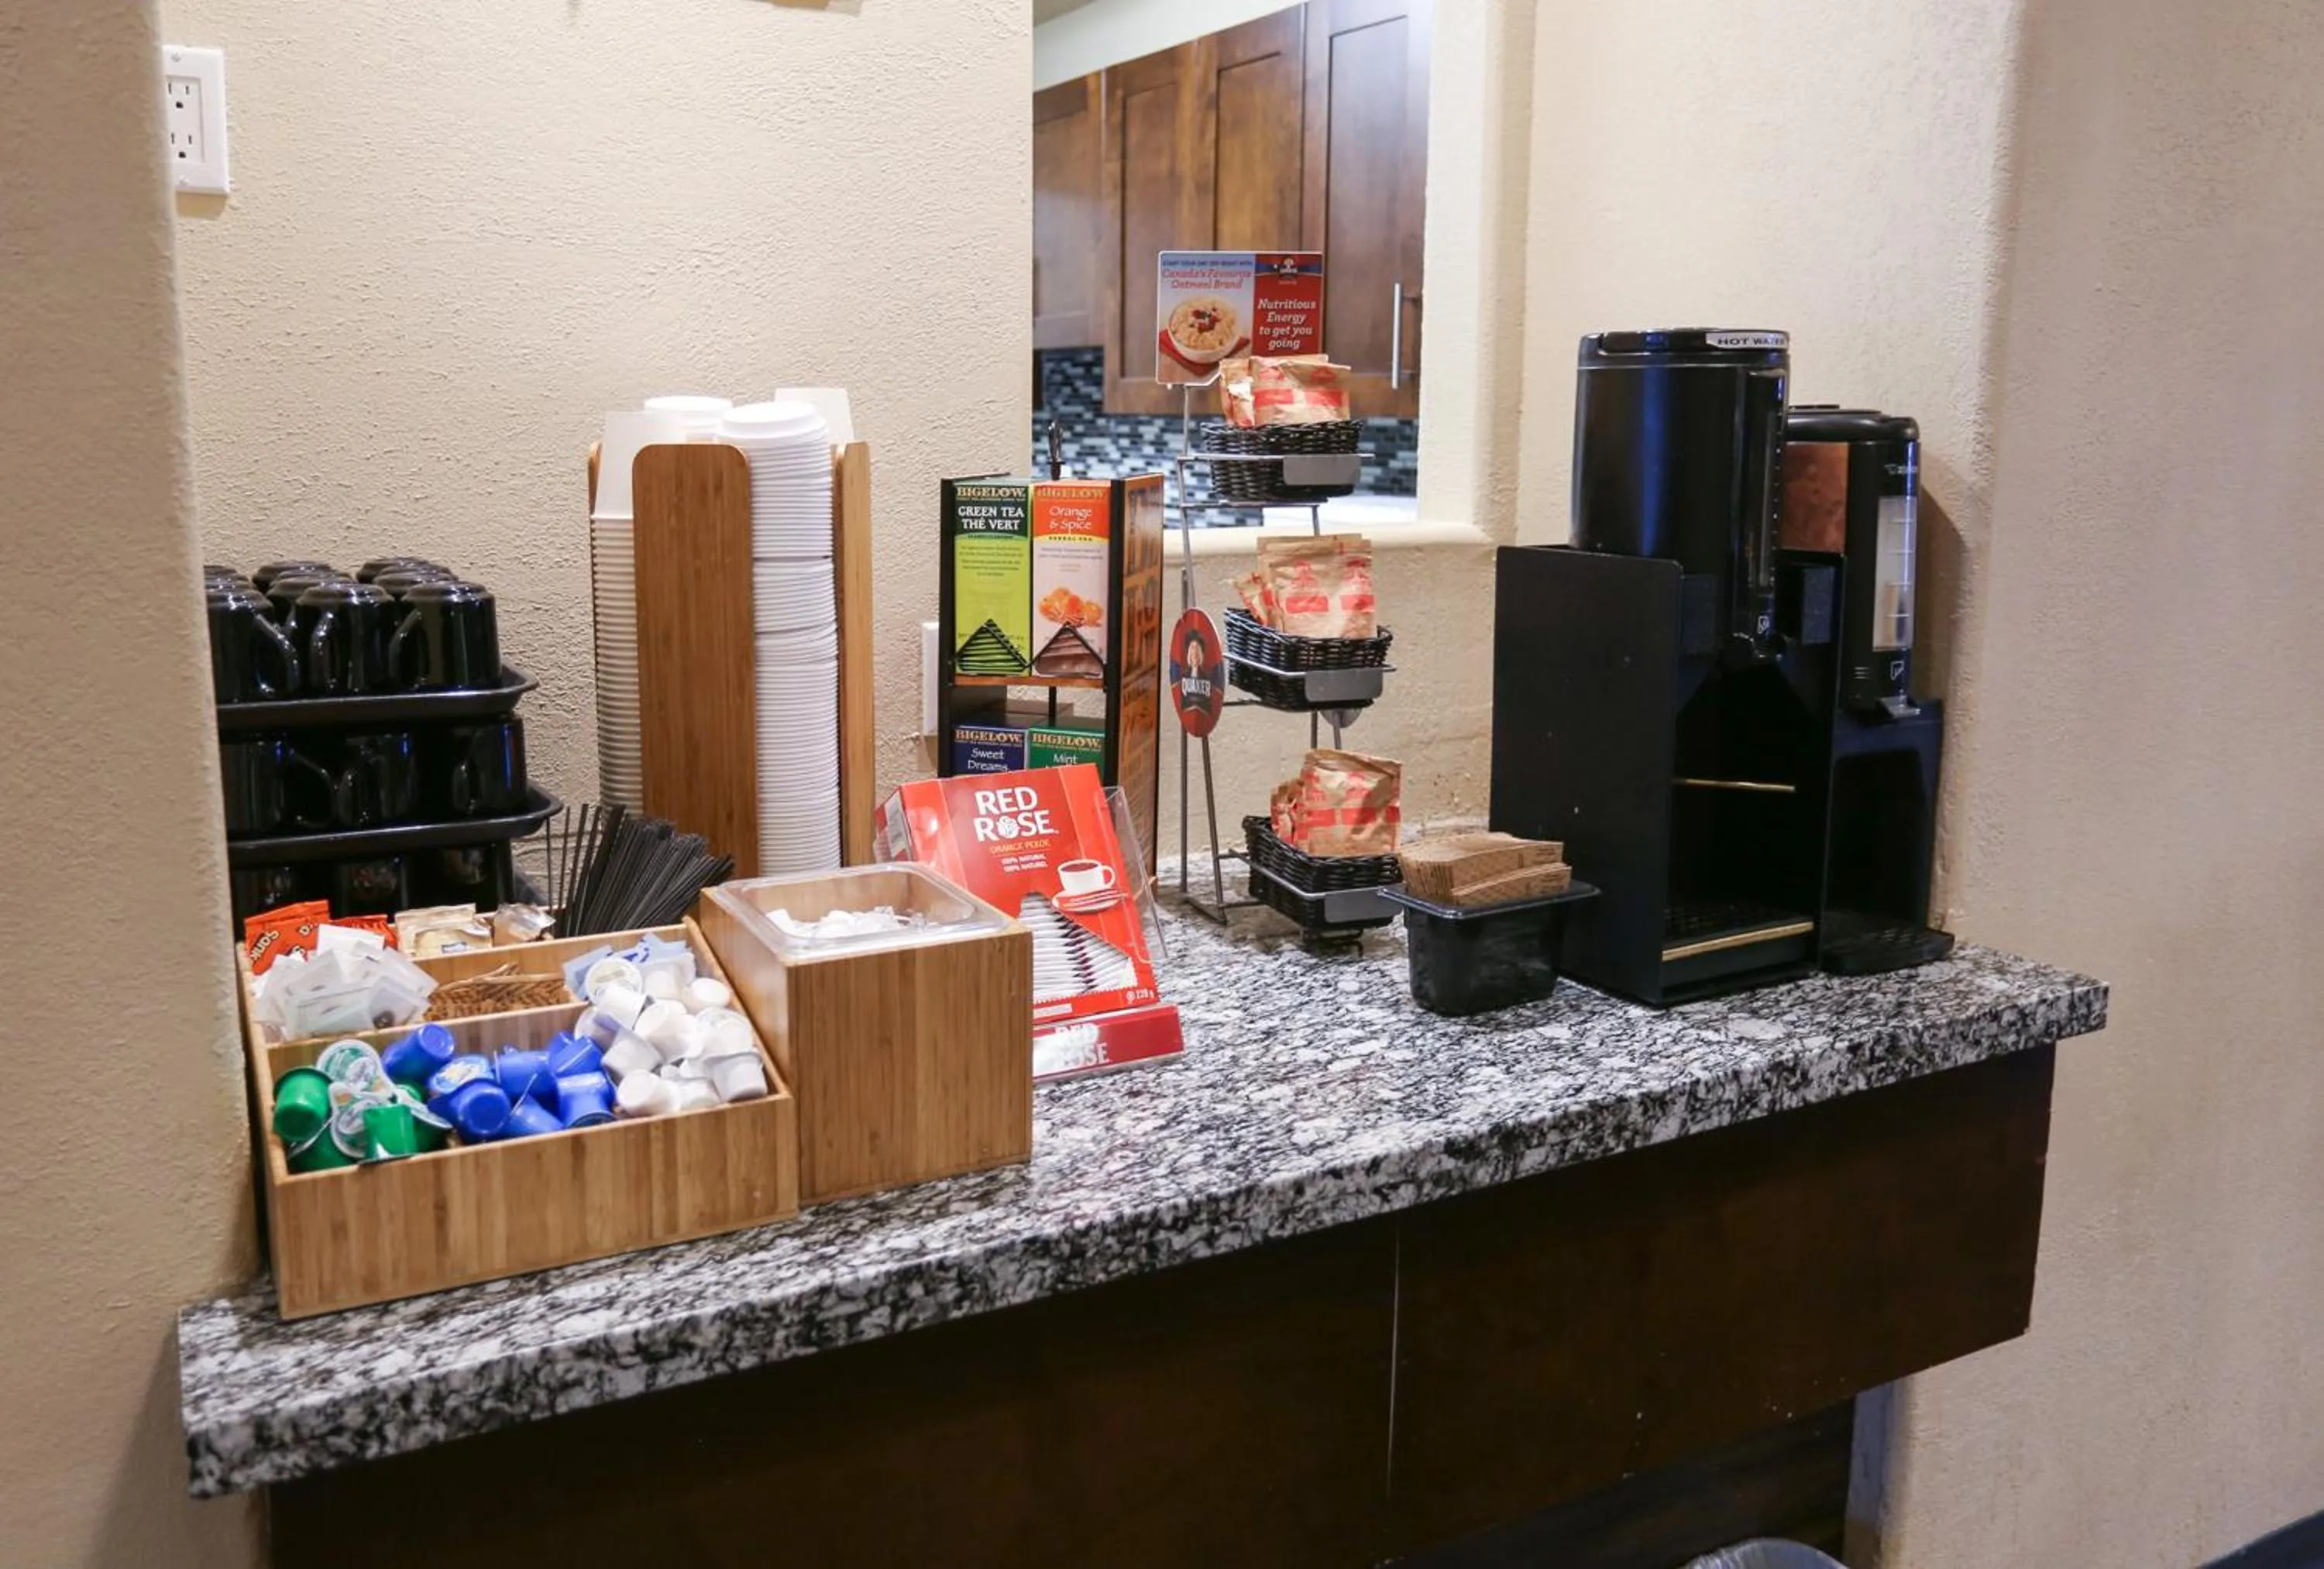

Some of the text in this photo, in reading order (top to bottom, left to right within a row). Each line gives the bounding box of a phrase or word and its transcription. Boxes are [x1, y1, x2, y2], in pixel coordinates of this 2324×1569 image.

[1171, 279, 1243, 289] Oatmeal Brand
[1257, 298, 1317, 310] Nutritious
[1267, 311, 1307, 324] Energy
[1259, 325, 1314, 337] to get you
[1268, 338, 1301, 351] going
[957, 486, 1025, 498] BIGELOW
[1037, 488, 1105, 499] BIGELOW
[958, 506, 1025, 517] GREEN TEA
[1049, 506, 1092, 521] Orange
[961, 517, 1021, 530] THÉ VERT
[1050, 520, 1092, 535] & Spice
[1181, 677, 1211, 697] QUAKER
[955, 730, 1023, 743] BIGELOW
[1032, 733, 1102, 747] BIGELOW
[971, 748, 1005, 760] Sweet
[1053, 753, 1079, 765] Mint
[968, 760, 1009, 771] Dreams
[975, 786, 1038, 815] RED
[973, 809, 1056, 842] ROSE
